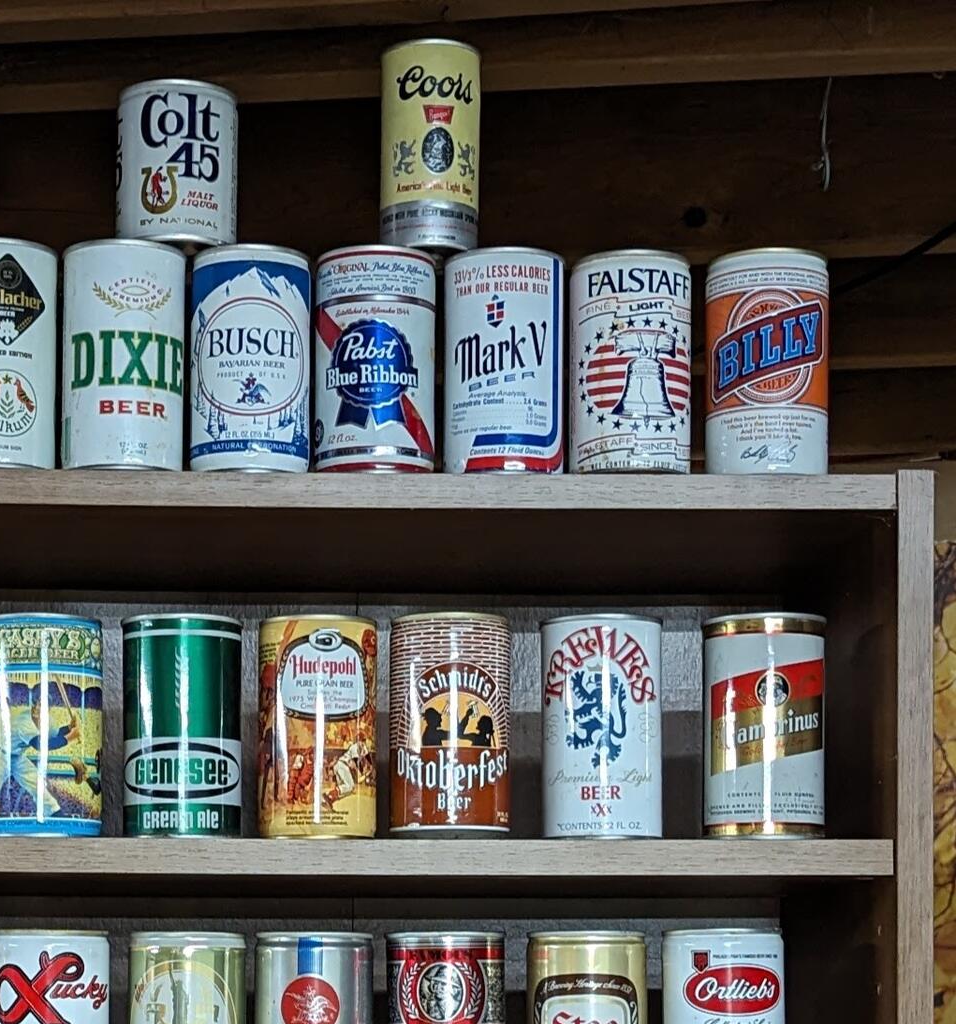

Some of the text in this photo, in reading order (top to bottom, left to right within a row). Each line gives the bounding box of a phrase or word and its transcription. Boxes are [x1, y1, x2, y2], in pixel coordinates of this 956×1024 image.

[397, 66, 473, 104] Coors
[141, 92, 221, 148] Colt
[166, 141, 220, 182] 45
[181, 199, 219, 211] LIQUOR
[486, 265, 551, 281] LESS CALORIES
[494, 281, 528, 293] REGULAR
[588, 267, 690, 298] FALSTAFF
[629, 301, 665, 312] LIGHT
[206, 327, 295, 359] BUSCH
[343, 332, 398, 361] Pabst
[454, 320, 547, 383] Mark V
[718, 312, 820, 389] BILLY
[71, 330, 183, 396] DIXIE
[327, 365, 417, 387] Blue Ribbon
[100, 400, 165, 419] BEER
[288, 655, 356, 678] Hudepohl
[397, 749, 508, 792] Oktoberfest
[695, 976, 775, 1001] Ortlieb's
